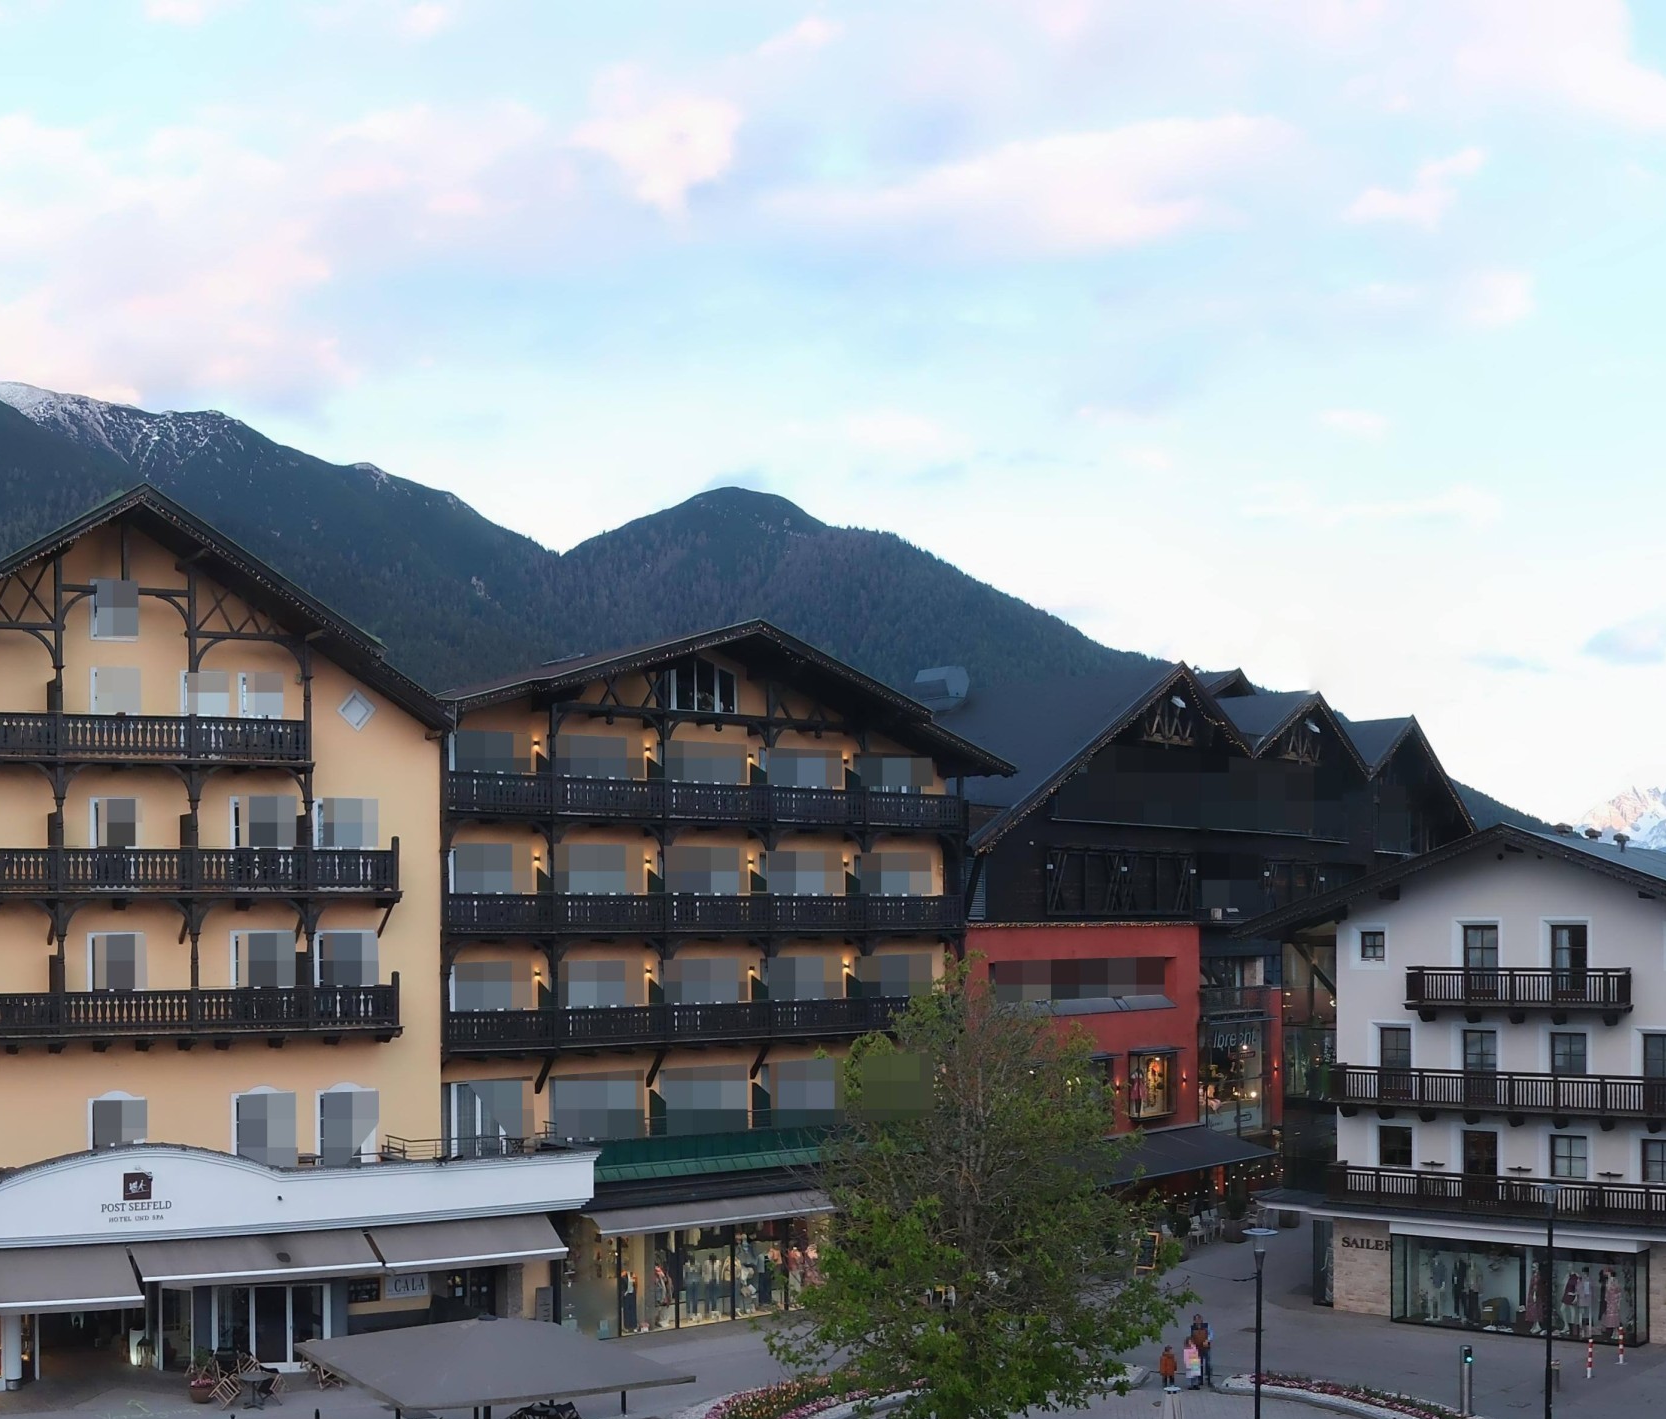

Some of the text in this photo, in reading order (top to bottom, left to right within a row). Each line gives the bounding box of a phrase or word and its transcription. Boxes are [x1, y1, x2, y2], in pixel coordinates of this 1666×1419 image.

[101, 1200, 172, 1213] POST SEEFELD
[394, 1277, 425, 1292] CALA
